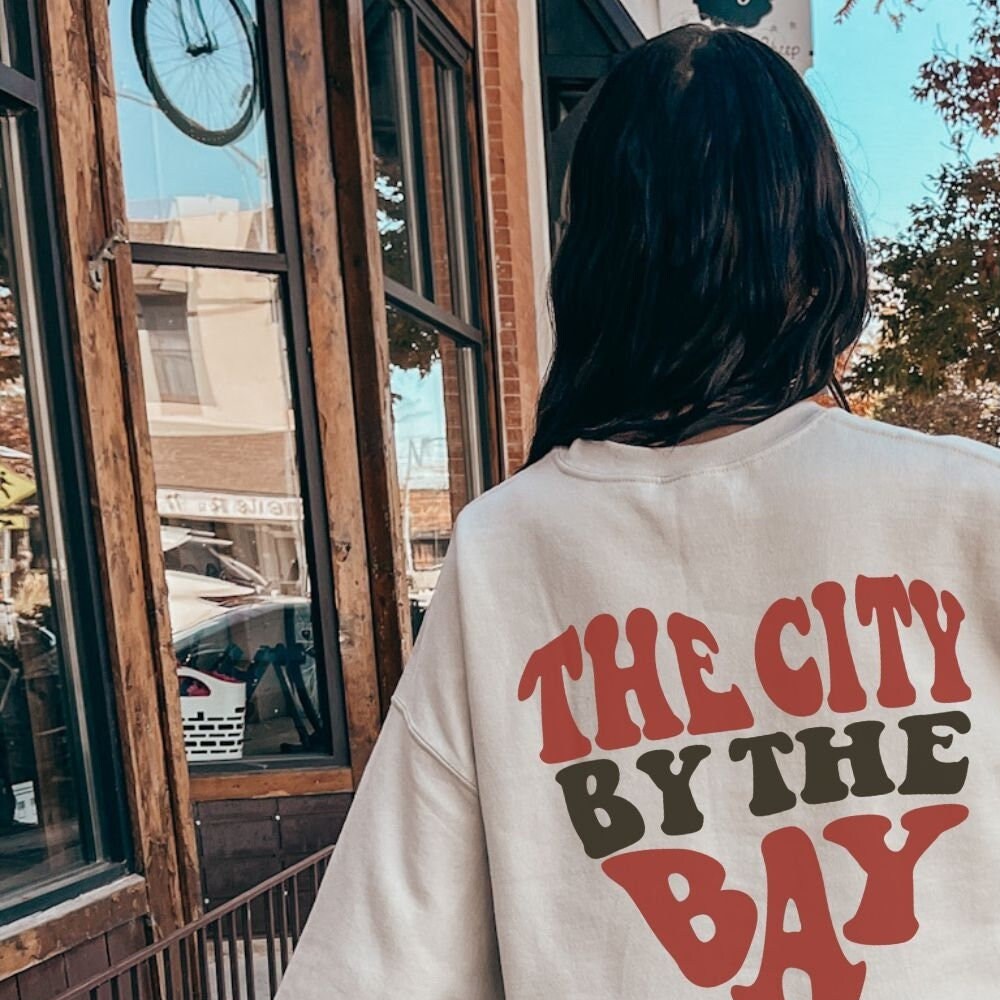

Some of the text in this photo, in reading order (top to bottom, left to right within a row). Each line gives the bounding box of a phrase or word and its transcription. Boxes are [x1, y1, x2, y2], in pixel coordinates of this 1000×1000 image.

[517, 574, 972, 764] THE CITY
[555, 710, 972, 860] BY THE
